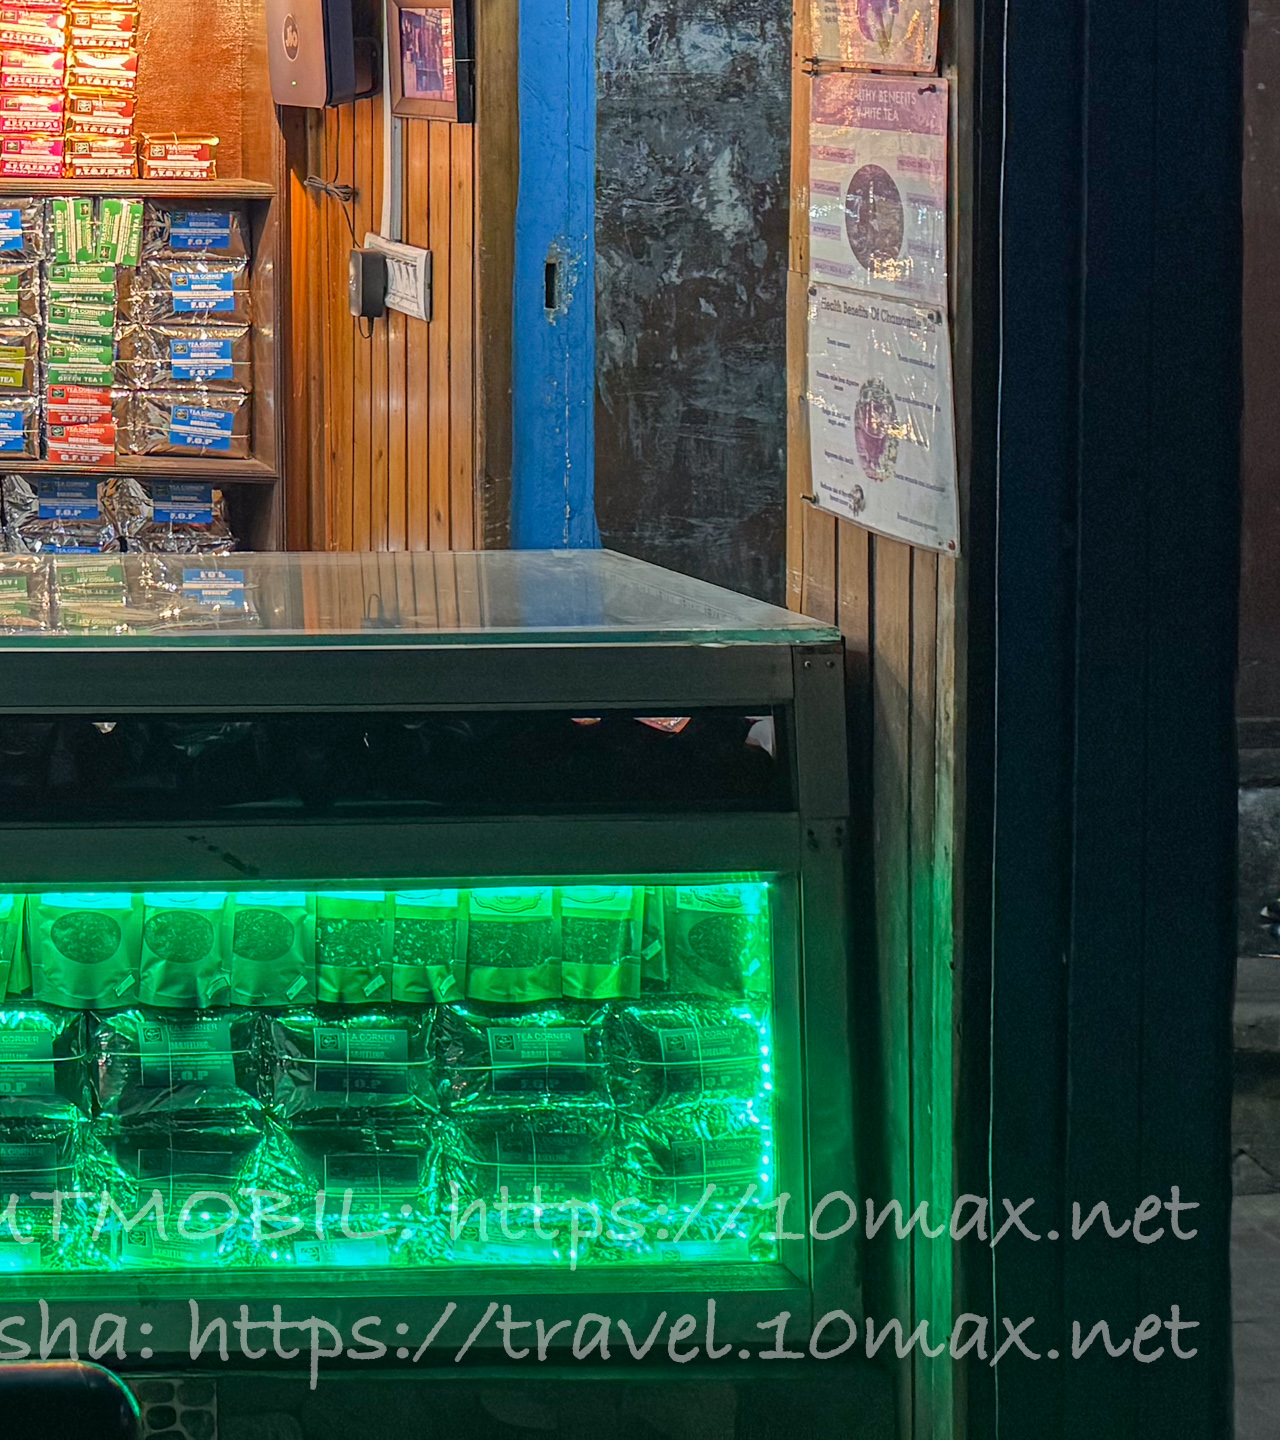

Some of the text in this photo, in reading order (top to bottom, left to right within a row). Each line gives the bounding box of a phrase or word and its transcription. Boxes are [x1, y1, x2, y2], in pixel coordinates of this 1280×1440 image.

[180, 1023, 218, 1031] CORNER
[1, 1035, 39, 1043] CORNER
[534, 1032, 572, 1040] CORNER
